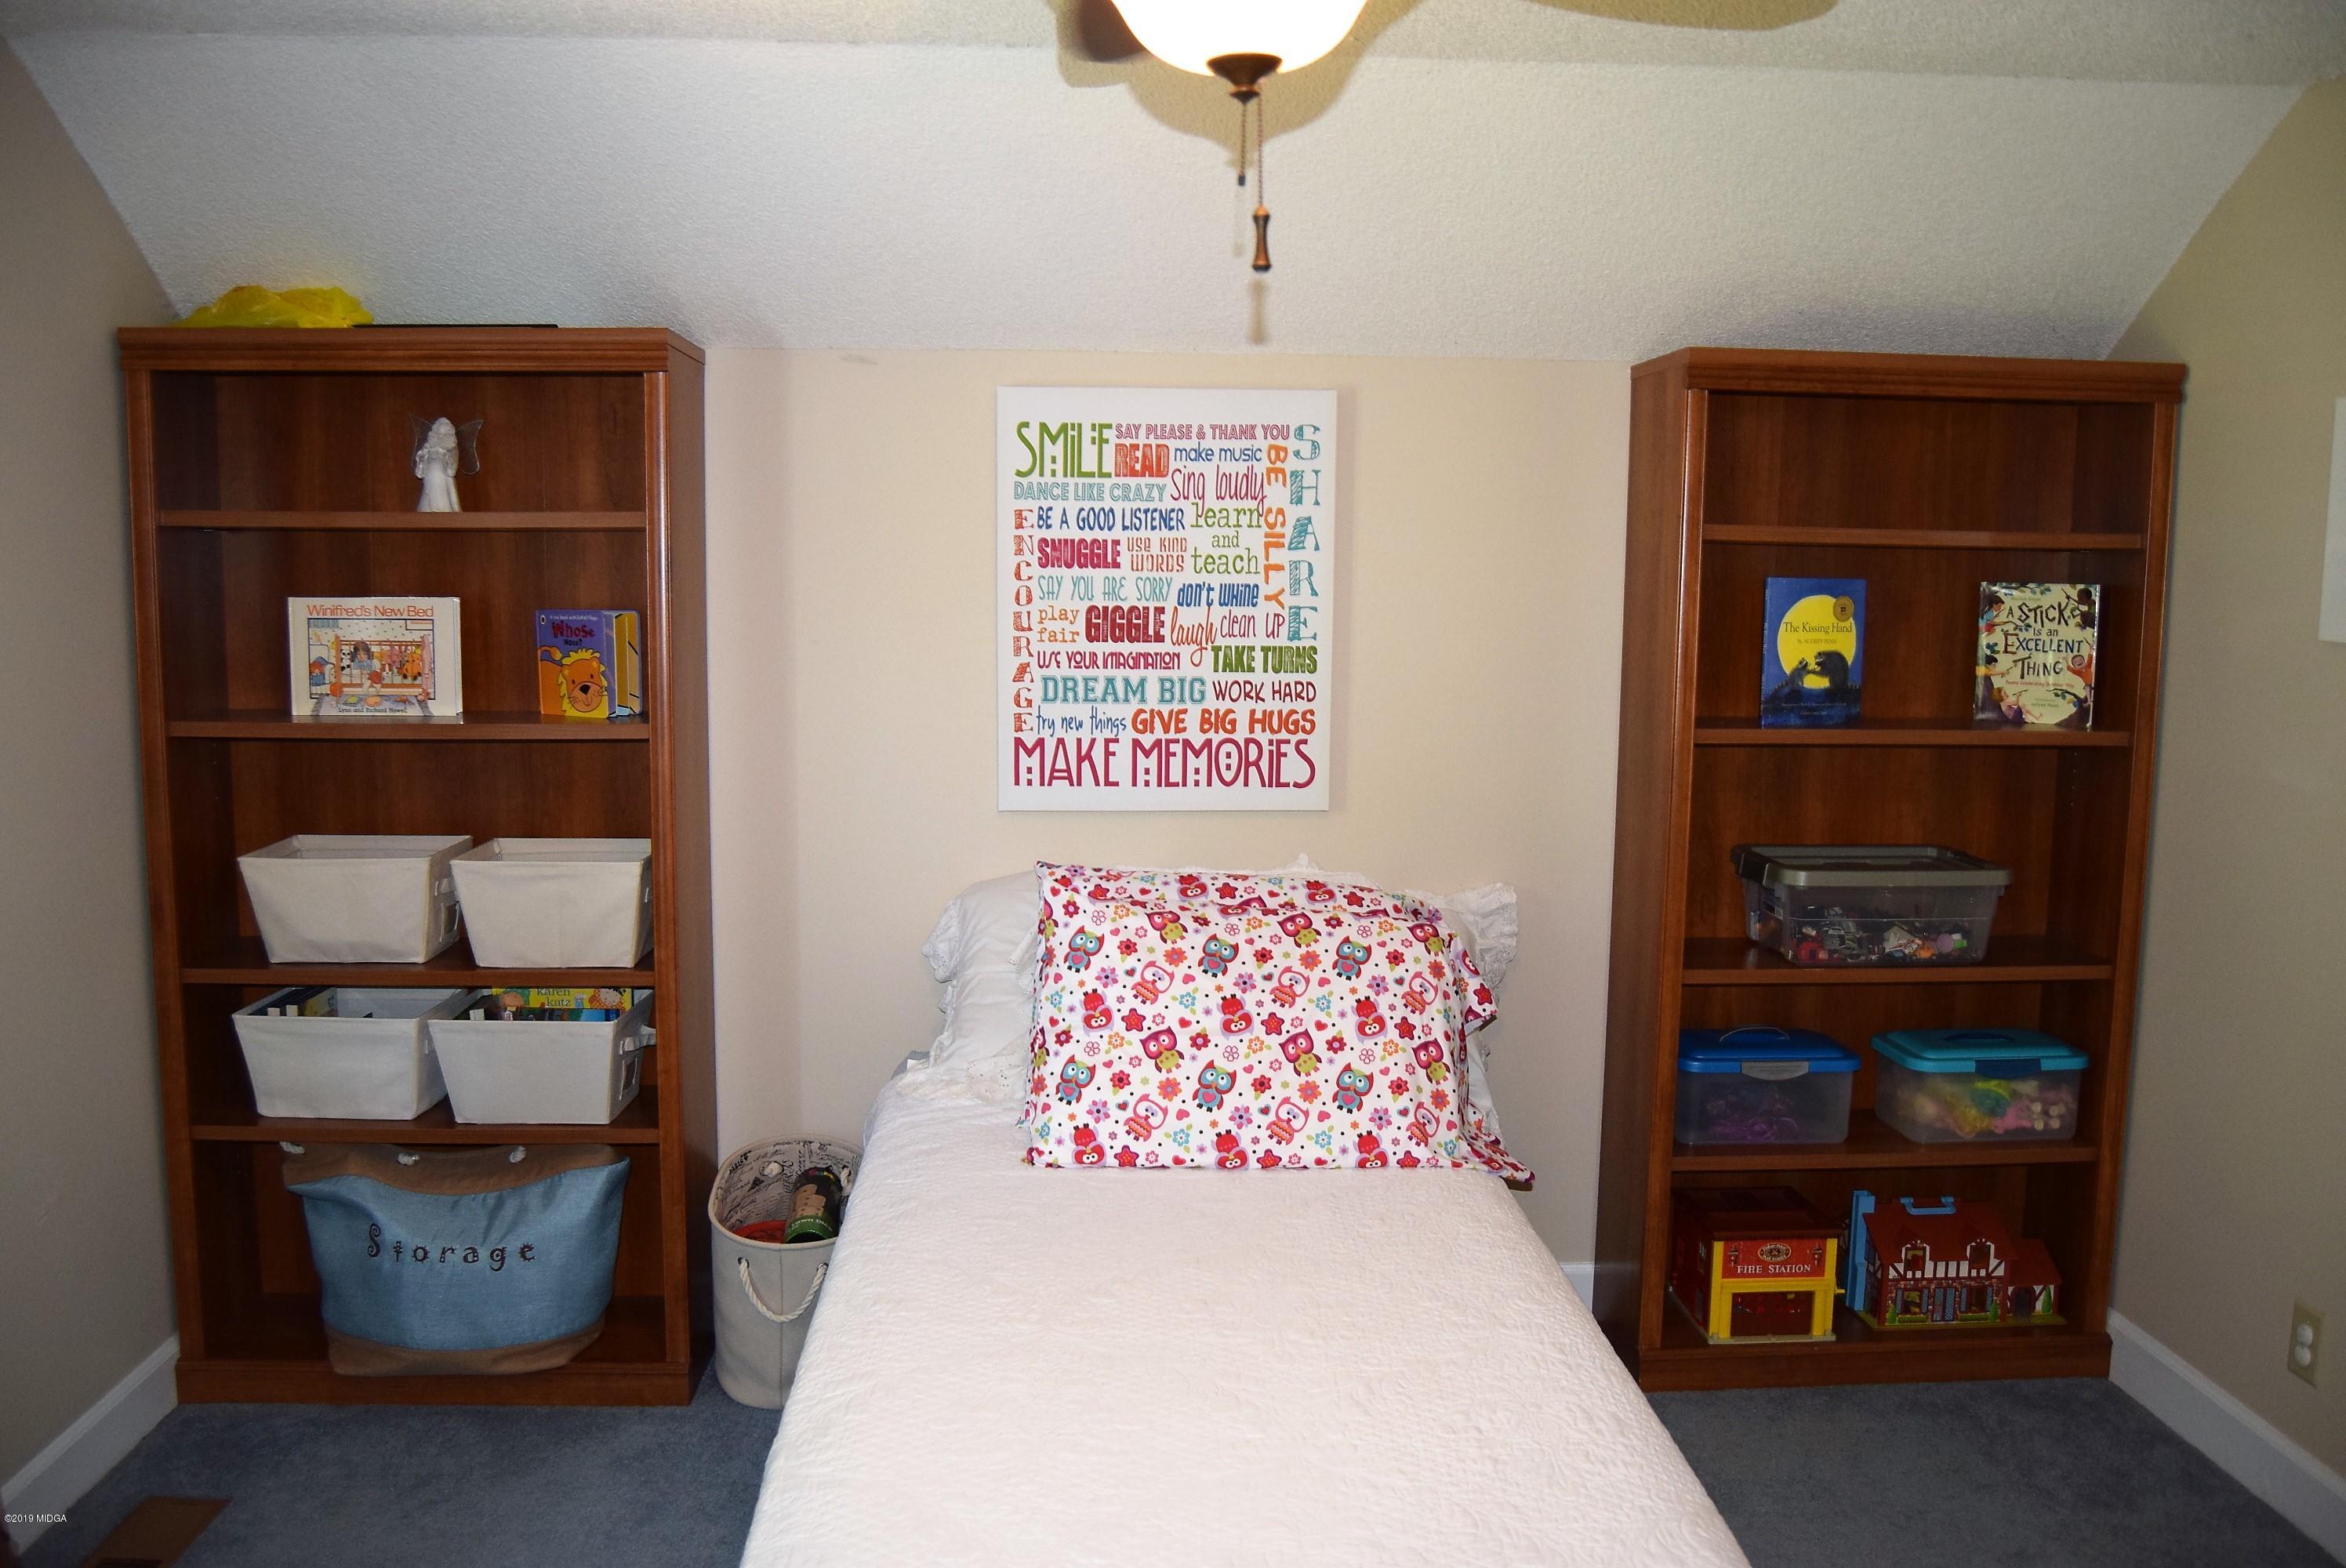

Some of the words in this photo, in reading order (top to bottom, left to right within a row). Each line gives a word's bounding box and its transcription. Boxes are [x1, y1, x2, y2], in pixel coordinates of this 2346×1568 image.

[1115, 423, 1142, 439] SAY
[1146, 423, 1192, 440] PLEASE
[1197, 424, 1206, 440] &
[1210, 424, 1257, 440] THANK
[1262, 424, 1290, 440] YOU
[1114, 443, 1169, 477] READ
[1174, 441, 1214, 462] make
[1219, 445, 1262, 462] music
[1266, 444, 1288, 488] BE
[1014, 481, 1069, 501] DANCE
[1074, 482, 1105, 502] LIKE
[1109, 483, 1167, 502] CRAZY
[1171, 466, 1205, 517] Sing
[1215, 464, 1266, 517] loudly
[1037, 506, 1053, 529] BE
[1060, 506, 1070, 530] A
[1077, 506, 1115, 532] GOOD
[1121, 507, 1185, 532] LISTENER
[1190, 502, 1262, 528] learn
[1160, 536, 1187, 553] KIND
[1211, 530, 1240, 547] and
[1287, 424, 1321, 641] SHARE
[1037, 537, 1120, 569] SNUGGLE
[1131, 554, 1184, 572] WORDS
[1191, 546, 1260, 574] teach
[1264, 506, 1286, 610] SILLY
[1038, 575, 1063, 600] SAY
[1070, 576, 1094, 601] YOU
[1102, 576, 1128, 601] ARE
[1136, 576, 1173, 602] SORRY
[1177, 581, 1215, 608] don't
[307, 604, 371, 616] Winifred's
[374, 605, 405, 616] New
[407, 605, 434, 616] Bed
[1012, 509, 1034, 733] ENCOURAGE
[1037, 604, 1080, 624] play
[1085, 604, 1165, 643] GIGGLE
[1220, 608, 1255, 638] clean
[2006, 605, 2014, 619] A
[2017, 601, 2069, 628] STICK
[552, 620, 595, 638] Whose
[1037, 627, 1080, 643] fair
[1171, 605, 1217, 666] laugh
[1783, 621, 1800, 633] The
[1802, 622, 1830, 634] Kissing
[1832, 622, 1852, 633] Hand
[2046, 628, 2058, 637] an
[2003, 630, 2083, 655] EXCELLENT
[1037, 651, 1060, 669] USE
[1066, 651, 1100, 670] YOUR
[1102, 651, 1180, 670] IMAGINATION
[1211, 645, 1255, 673] TAKE
[1260, 645, 1318, 673] TURNS
[2012, 653, 2063, 680] THING
[1040, 674, 1148, 704] DREAM
[1157, 676, 1207, 705] BIG
[1212, 680, 1266, 703] WORK
[1272, 680, 1316, 702] HARD
[1037, 705, 1055, 737] try
[1061, 715, 1083, 733] new
[1089, 705, 1127, 737] things
[1131, 708, 1188, 735] GIVE
[1199, 708, 1237, 735] BIG
[1248, 708, 1316, 735] HUGS
[1013, 737, 1120, 787] MAKE
[546, 996, 571, 1007] katz
[368, 1223, 536, 1272] Storage
[1737, 1265, 1763, 1274] FIRE
[1768, 1264, 1811, 1273] STATION
